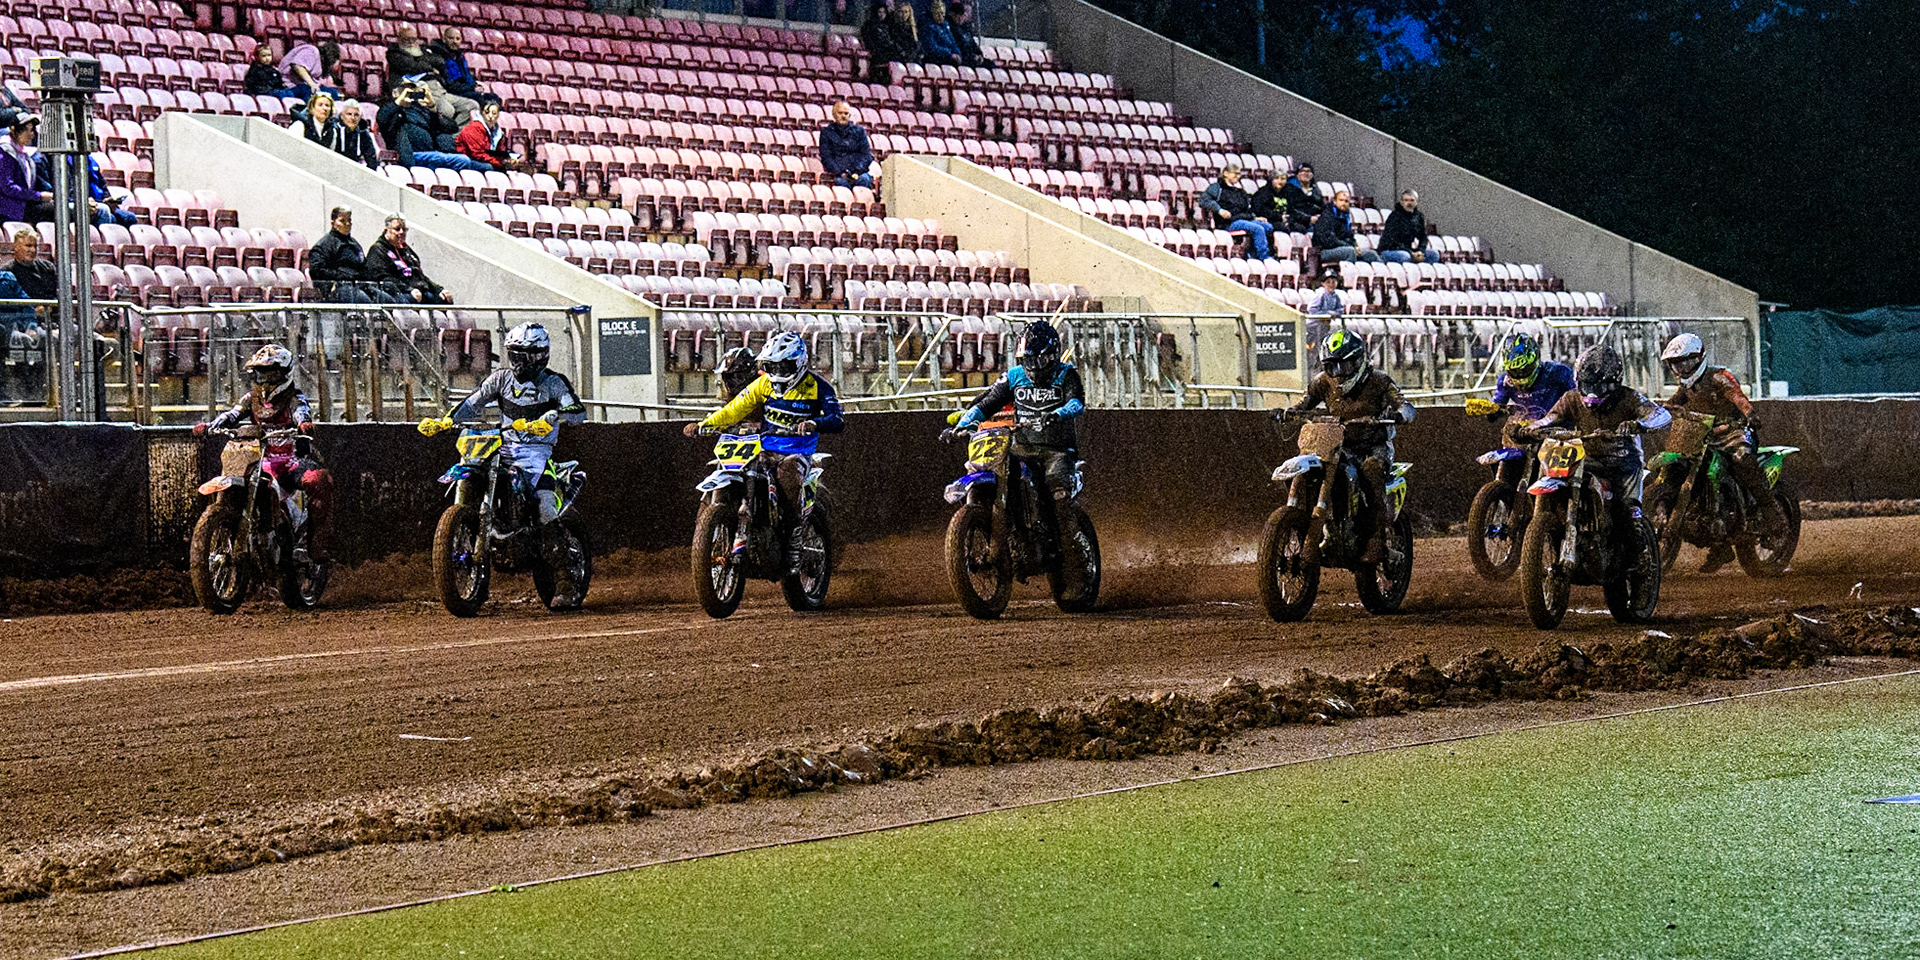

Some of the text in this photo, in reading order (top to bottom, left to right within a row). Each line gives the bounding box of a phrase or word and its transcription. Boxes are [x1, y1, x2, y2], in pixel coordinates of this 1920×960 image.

[601, 320, 637, 331] BLOCK E
[1278, 324, 1284, 332] F
[1279, 342, 1285, 350] G
[718, 443, 757, 460] 34
[970, 437, 1003, 462] 22
[1544, 446, 1578, 468] 69
